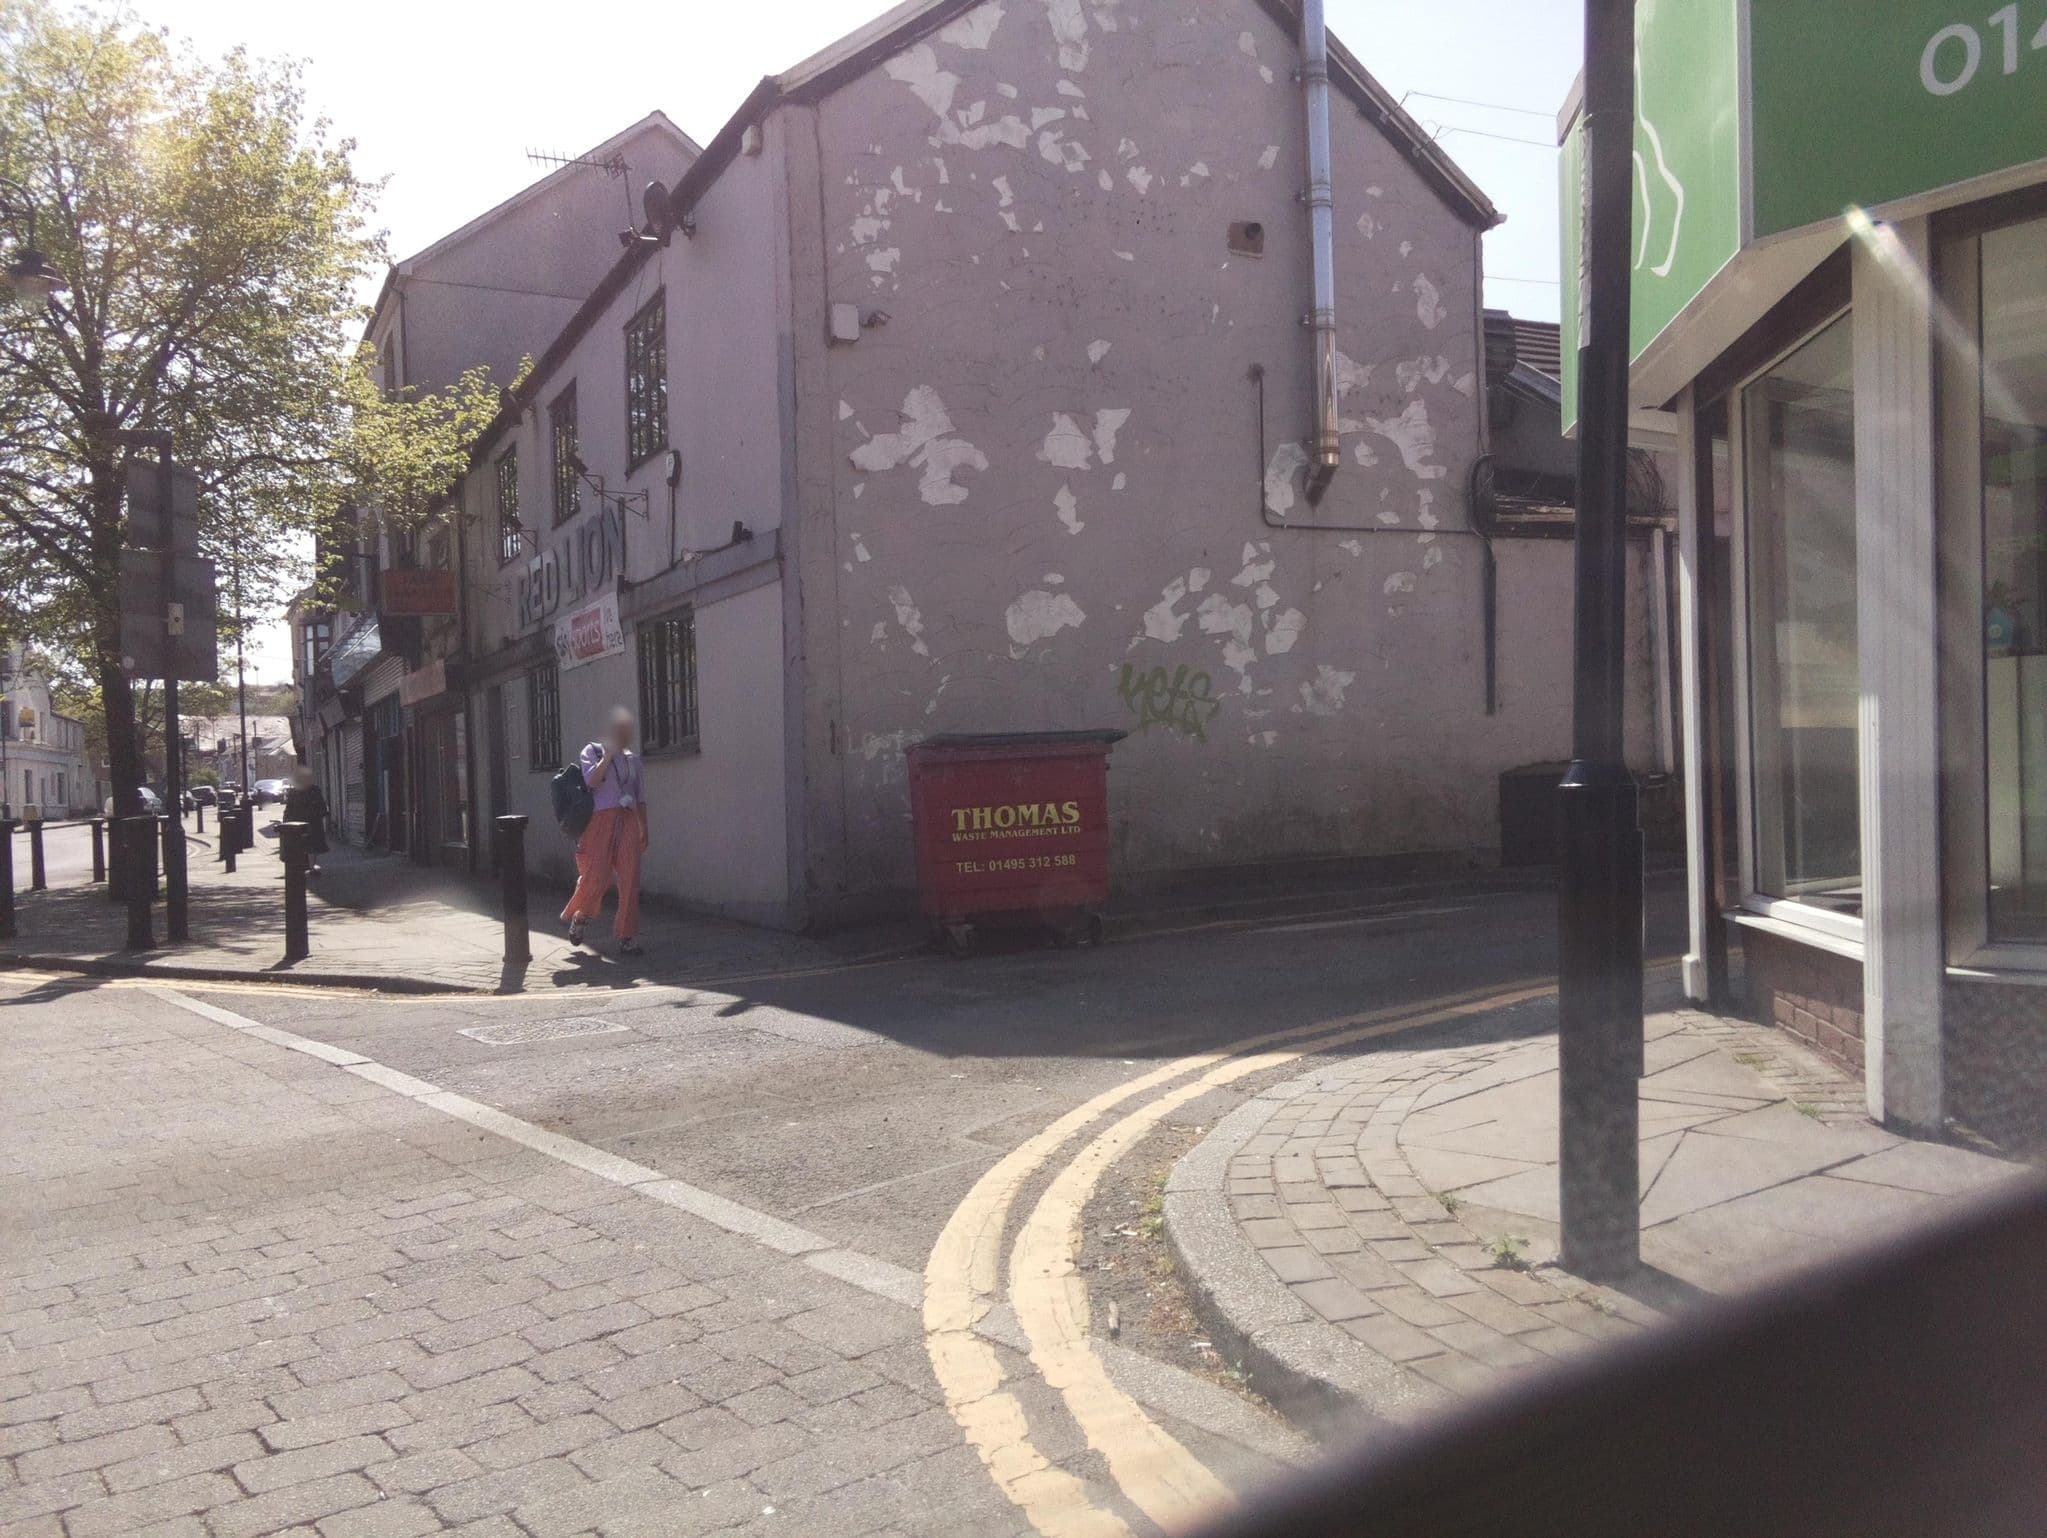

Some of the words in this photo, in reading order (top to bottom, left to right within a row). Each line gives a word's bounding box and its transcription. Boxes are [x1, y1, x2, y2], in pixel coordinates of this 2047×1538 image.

[518, 549, 561, 631] RED
[560, 497, 627, 606] LION
[951, 801, 1080, 830] THOMAS
[952, 832, 988, 843] WASTE
[990, 827, 1058, 839] MANAGEMENT
[1061, 825, 1081, 835] LTD
[956, 861, 985, 873] TEL:
[988, 858, 1026, 872] 01495
[1029, 856, 1051, 868] 312
[1054, 854, 1076, 866] 588
